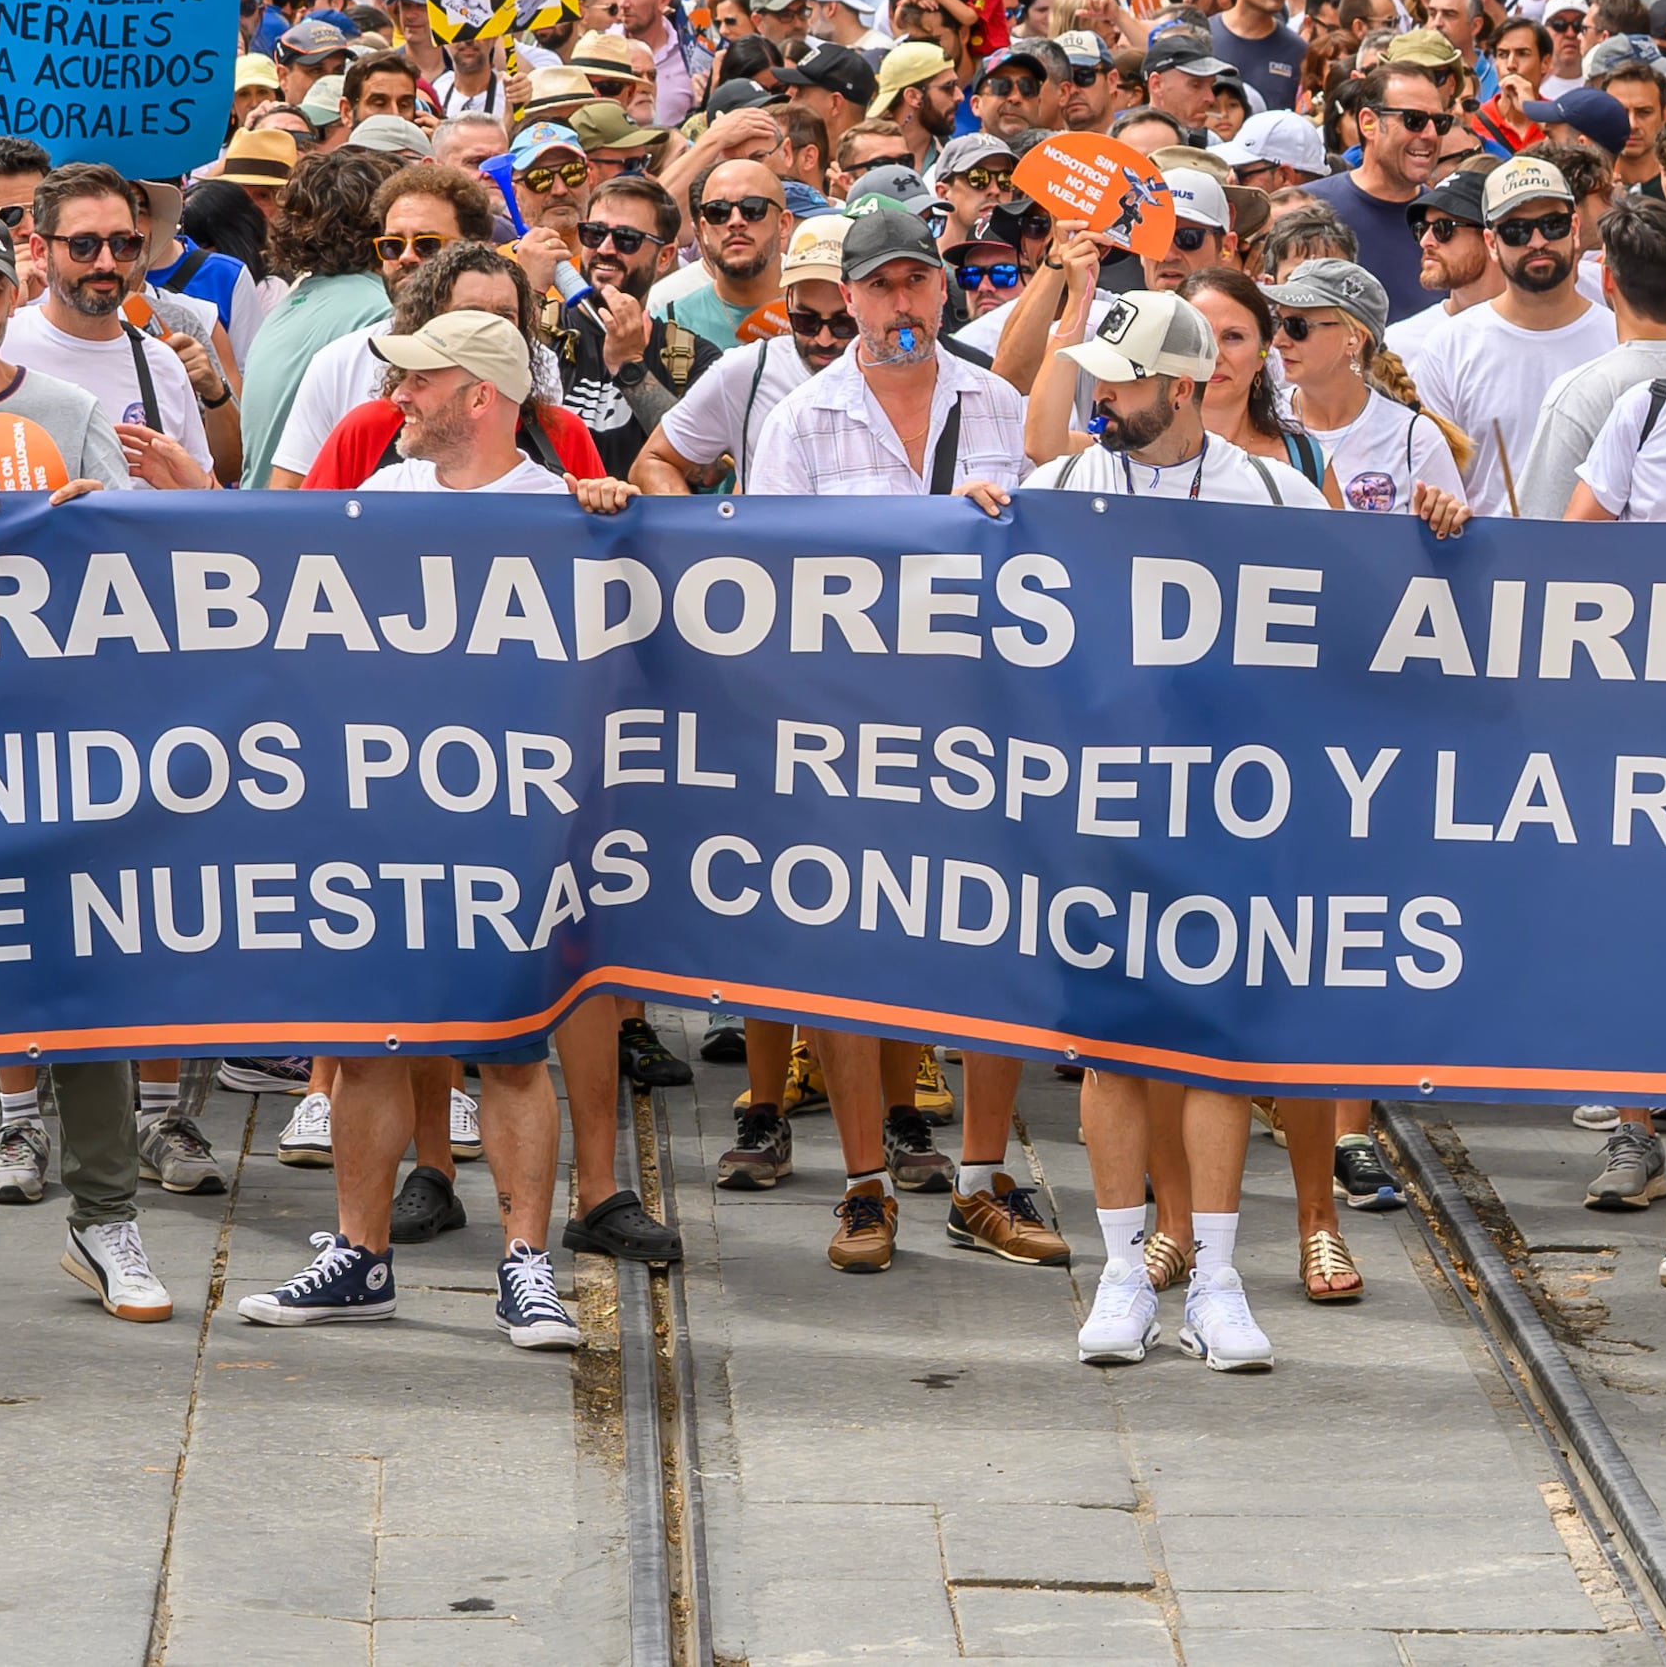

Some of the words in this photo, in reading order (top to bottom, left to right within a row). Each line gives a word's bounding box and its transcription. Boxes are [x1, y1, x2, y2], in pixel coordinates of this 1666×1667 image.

[33, 50, 221, 90] ACUERDOS
[1042, 144, 1111, 187] NOSOTROS
[1094, 154, 1118, 174] SIN
[1047, 181, 1097, 216] VUELA!!!
[1064, 174, 1085, 191] NO
[1085, 185, 1104, 202] SE
[1502, 177, 1550, 195] Chang
[0, 455, 14, 478] NO
[34, 465, 49, 491] SIN
[1132, 557, 1322, 667] DE
[345, 724, 578, 816] POR
[604, 709, 737, 789] EL
[775, 720, 1290, 838] RESPETO
[1327, 746, 1401, 839] Y
[1436, 751, 1577, 846] LA
[71, 830, 650, 956] NUESTRAS
[691, 835, 1465, 990] CONDICIONES
